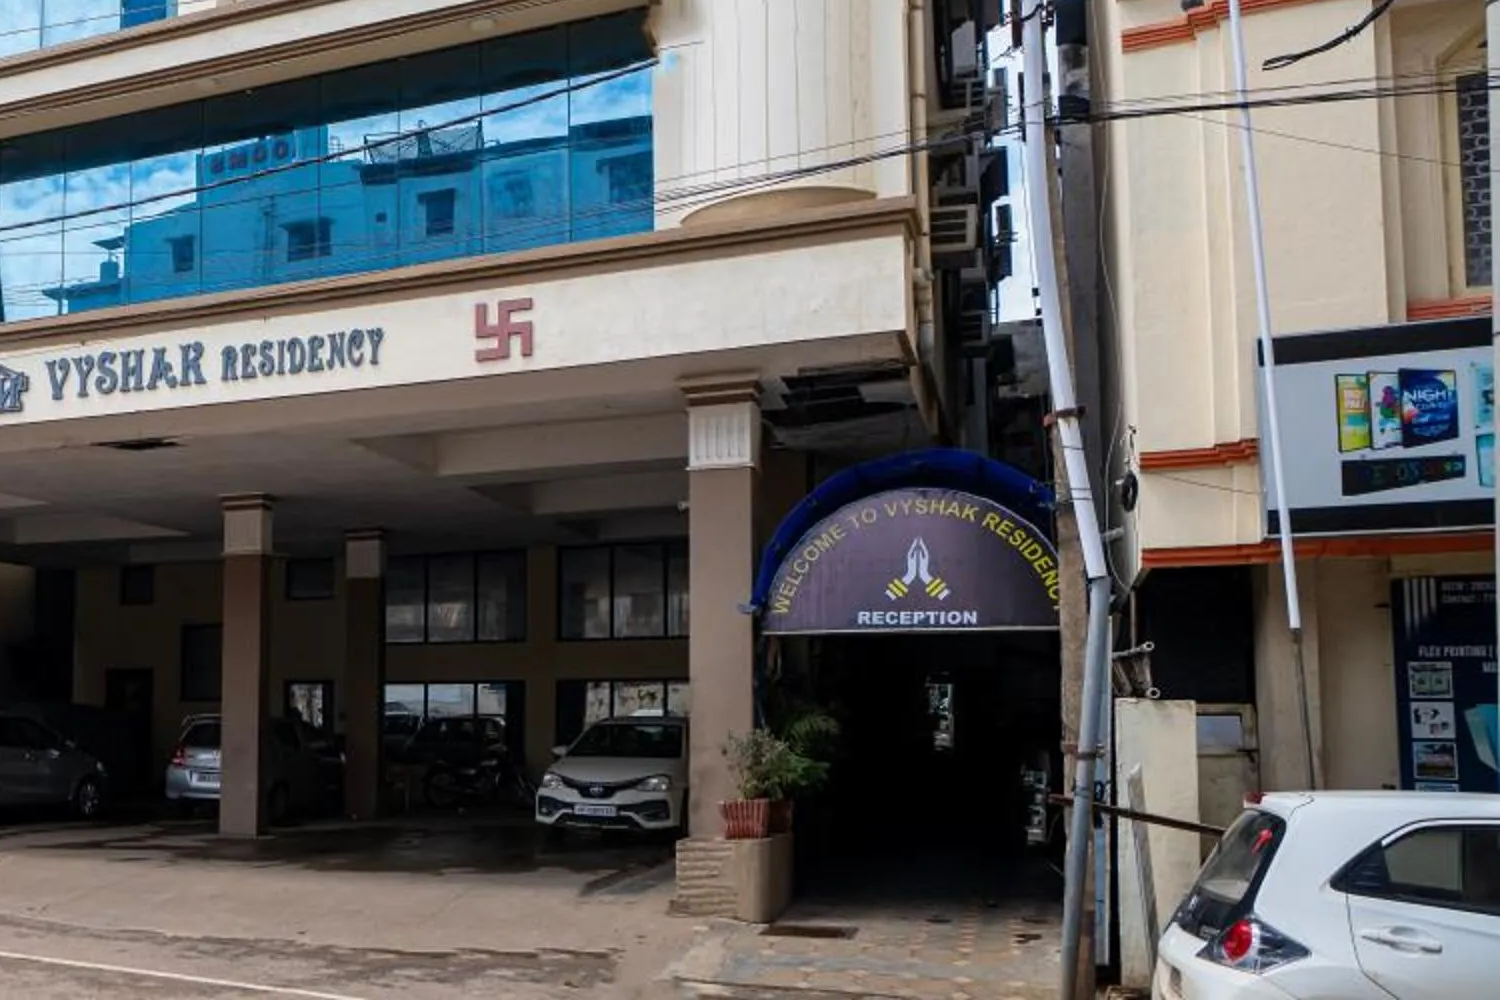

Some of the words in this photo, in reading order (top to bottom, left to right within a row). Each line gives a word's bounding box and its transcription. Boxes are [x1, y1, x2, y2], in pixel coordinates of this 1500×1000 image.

[45, 340, 207, 400] VYSHAK
[220, 327, 385, 381] RESIDENCY
[771, 523, 848, 615] WELCOME
[847, 507, 877, 529] TO
[884, 499, 980, 522] VYSHAK
[981, 511, 1060, 610] RESIDENC
[857, 610, 978, 626] RECEPTION
